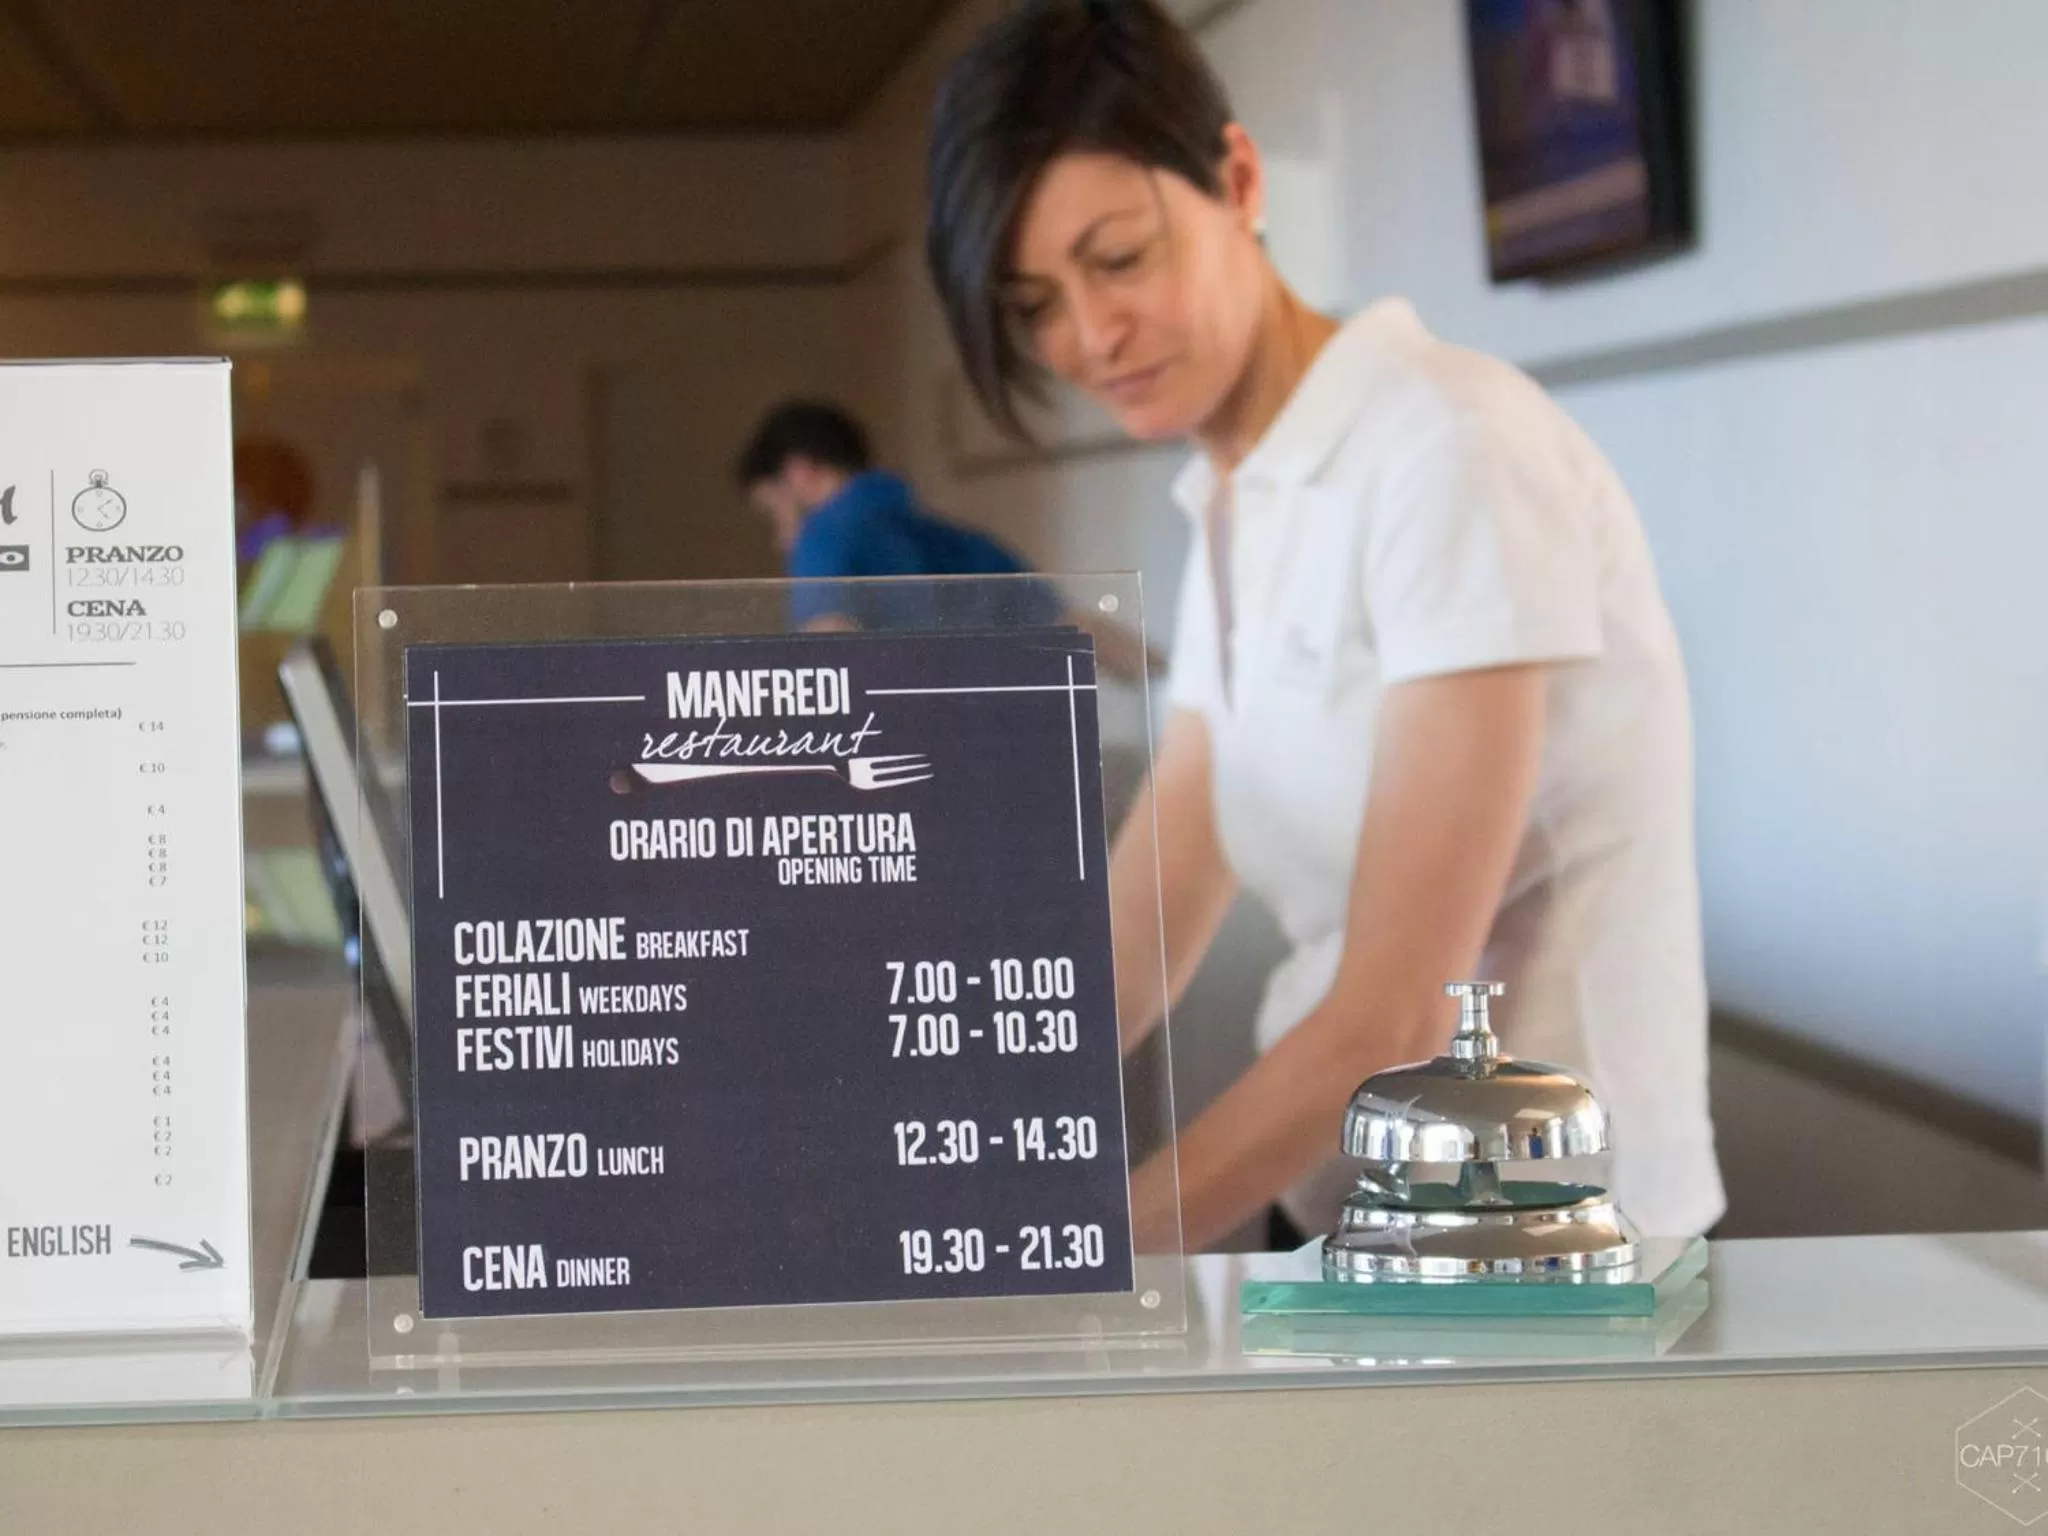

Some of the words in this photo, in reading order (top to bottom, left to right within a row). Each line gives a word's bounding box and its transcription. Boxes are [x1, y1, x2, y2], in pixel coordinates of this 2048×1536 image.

[65, 545, 185, 564] PRANZO
[67, 599, 147, 617] CENA
[1, 710, 57, 722] pensione
[666, 667, 851, 719] MANFREDI
[641, 711, 883, 760] restaurant
[609, 818, 717, 861] ORARIO
[725, 817, 754, 858] DI
[762, 812, 917, 856] APERTURA
[778, 856, 863, 886] OPENING
[867, 855, 917, 883] TIME
[454, 917, 627, 965] COLAZIONE
[636, 929, 750, 959] BREAKFAST
[455, 971, 571, 1018] FERIALI
[579, 984, 688, 1015] WEEKDAYS
[885, 960, 957, 1005] 7.00
[990, 956, 1075, 1002] 10.00
[456, 1025, 573, 1072] FESTIVI
[582, 1038, 679, 1068] HOLIDAYS
[888, 1012, 960, 1058] 7.00
[993, 1009, 1078, 1055] 10.30
[459, 1132, 588, 1181] PRANZO
[597, 1145, 664, 1176] LUNCH
[893, 1119, 979, 1166] 12.30
[1012, 1115, 1098, 1162] 14.30
[7, 1223, 112, 1258] ENGLISH
[462, 1244, 548, 1292] CENA
[556, 1257, 631, 1288] DINNER
[899, 1228, 985, 1275] 19.30
[1019, 1223, 1105, 1270] 21.30
